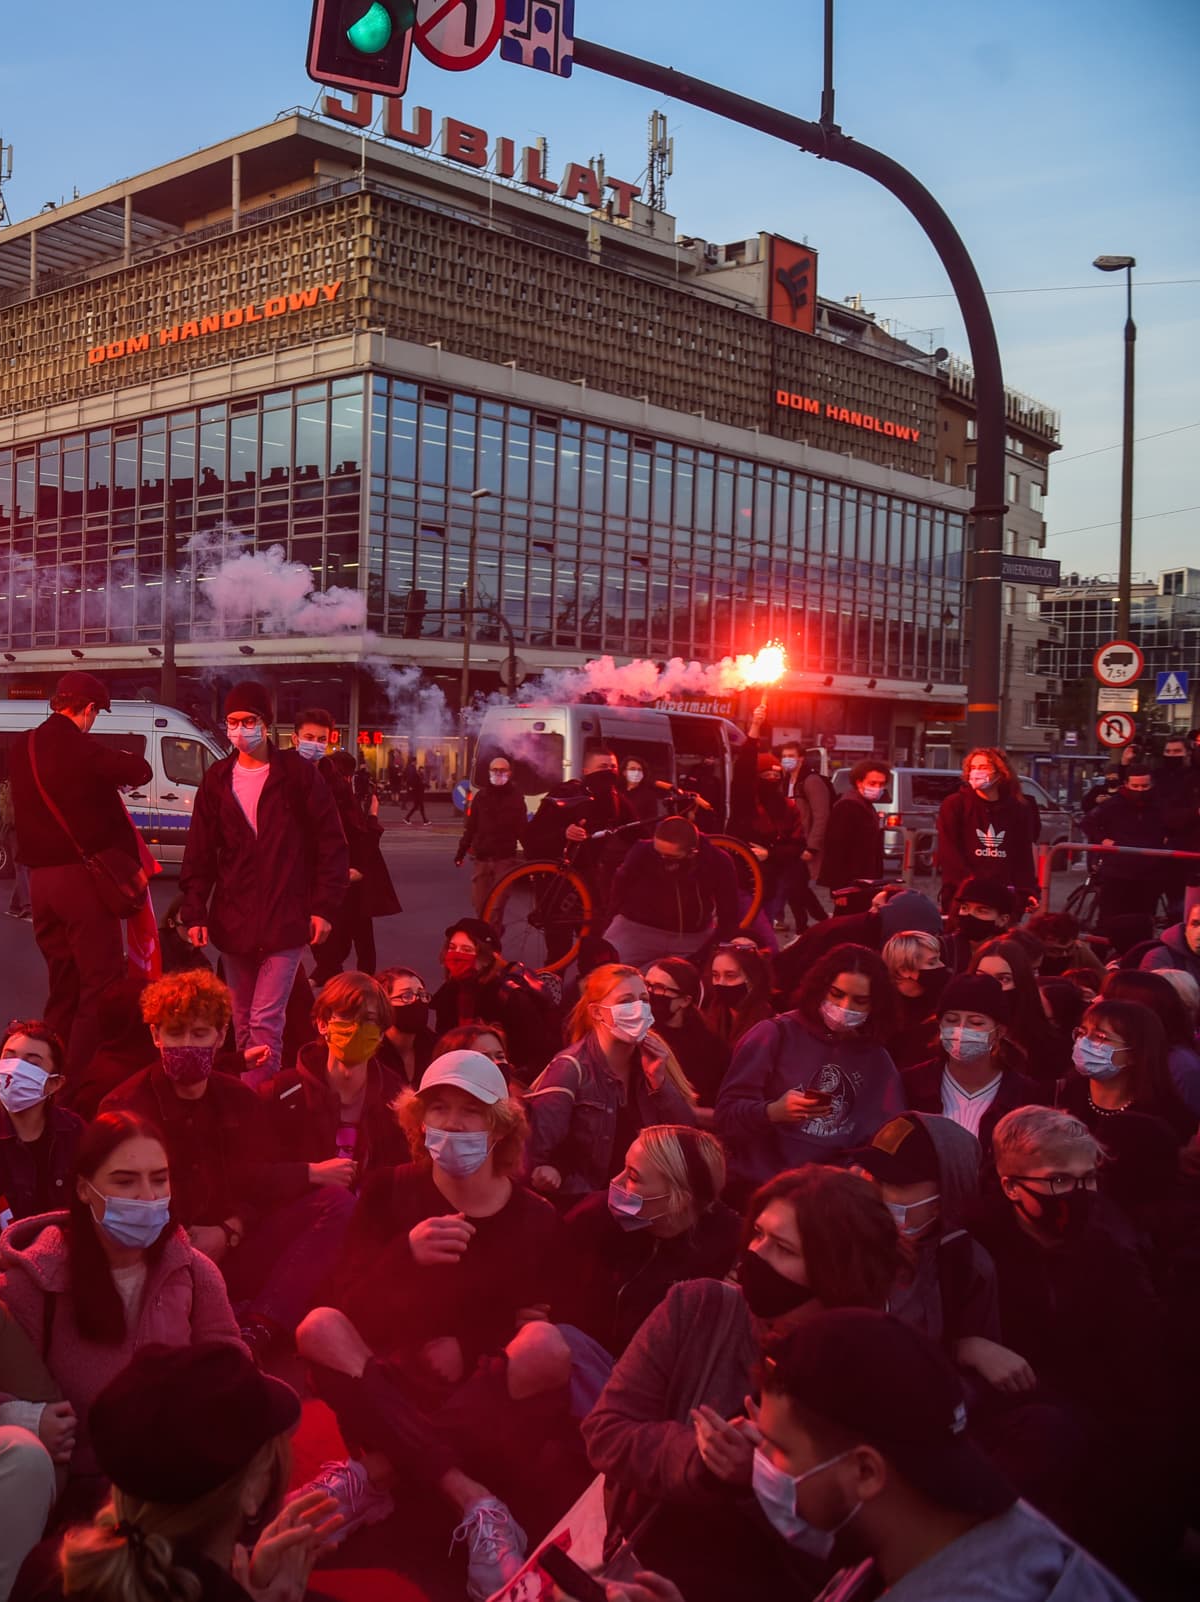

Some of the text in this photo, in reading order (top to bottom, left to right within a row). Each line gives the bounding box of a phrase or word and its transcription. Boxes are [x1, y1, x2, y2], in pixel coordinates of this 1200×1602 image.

[321, 88, 641, 219] JUBILAT
[88, 281, 343, 365] DOM HANDLOWY
[776, 389, 921, 442] DOM HANDLOWY
[655, 699, 732, 714] supermarket
[975, 847, 1007, 858] adidas
